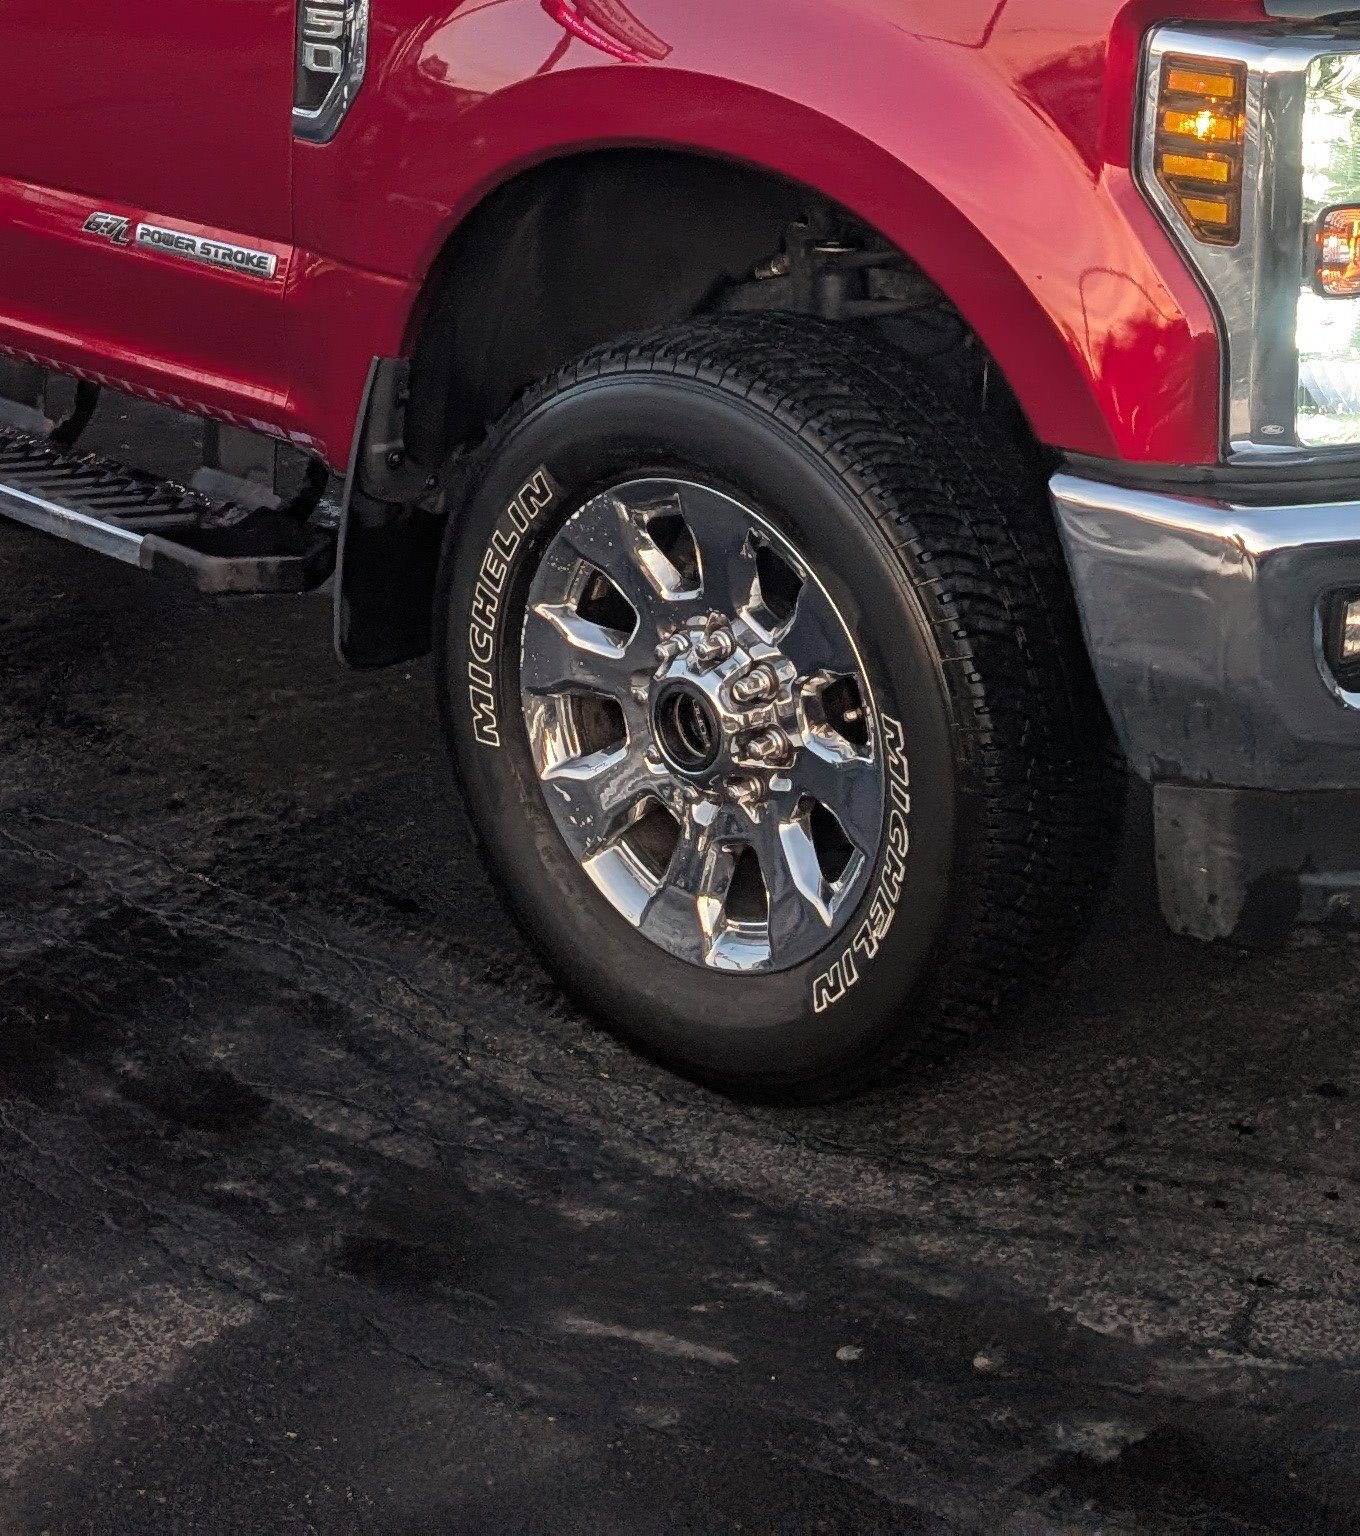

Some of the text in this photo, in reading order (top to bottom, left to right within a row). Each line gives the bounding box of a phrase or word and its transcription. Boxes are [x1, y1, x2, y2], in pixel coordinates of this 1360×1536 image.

[139, 226, 197, 255] POWER
[199, 241, 270, 271] STROKE
[468, 470, 553, 747] MICHELIN
[812, 712, 911, 1013] MICHELIN
